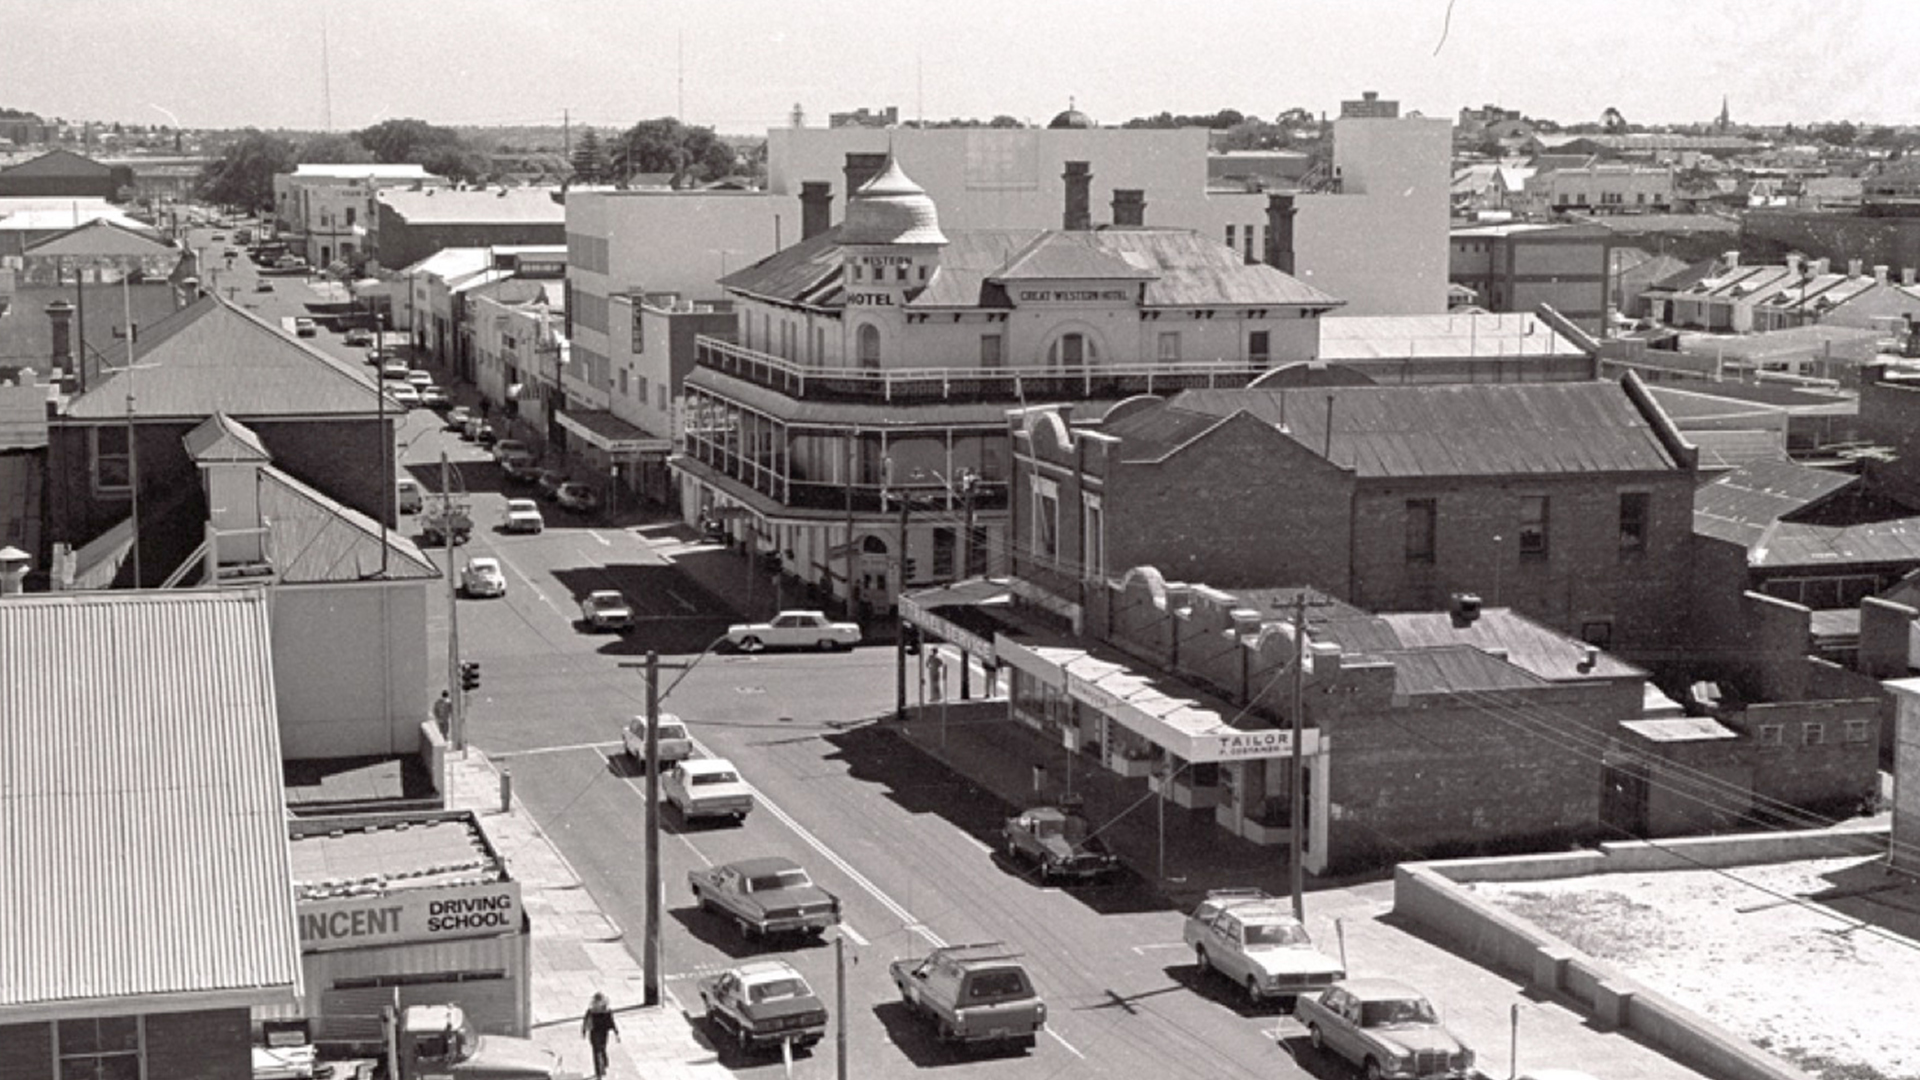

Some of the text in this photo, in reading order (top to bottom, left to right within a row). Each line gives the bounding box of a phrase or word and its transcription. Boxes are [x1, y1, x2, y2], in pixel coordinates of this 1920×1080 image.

[847, 293, 895, 306] HOTEL
[1021, 291, 1050, 301] GREAT
[1054, 291, 1098, 301] WESTERN
[1220, 733, 1288, 747] TAILOR
[429, 895, 511, 916] DRIVING
[428, 913, 510, 932] SCHOOL
